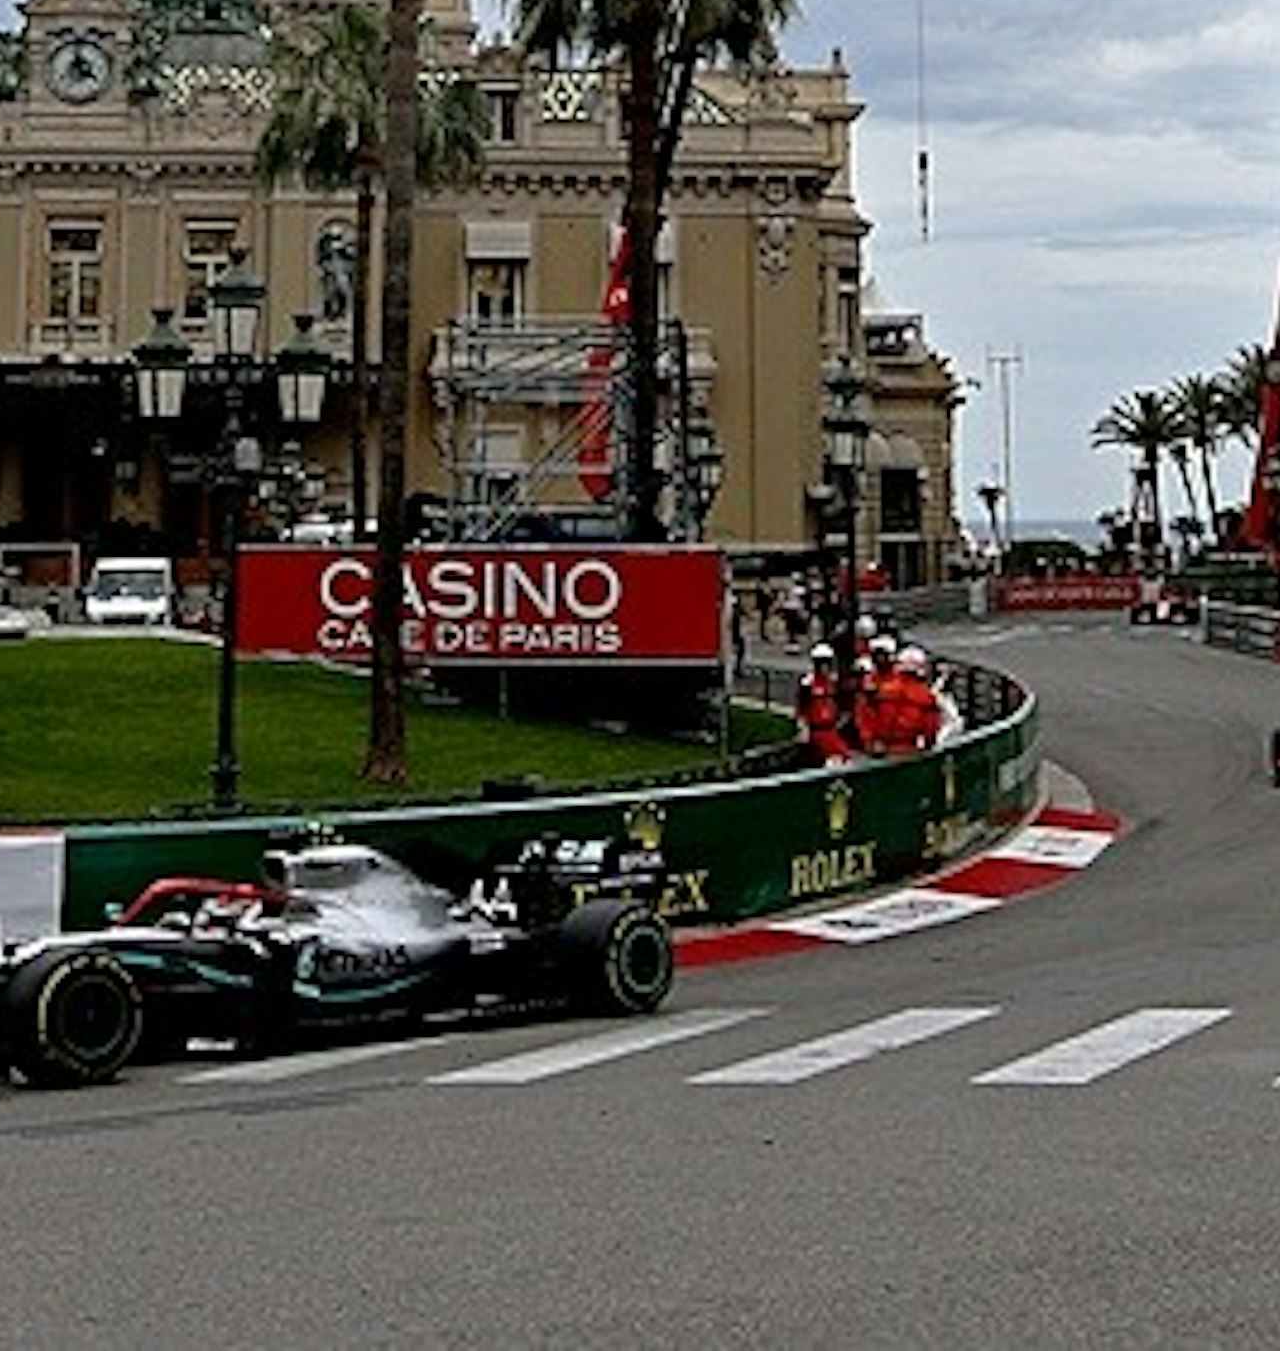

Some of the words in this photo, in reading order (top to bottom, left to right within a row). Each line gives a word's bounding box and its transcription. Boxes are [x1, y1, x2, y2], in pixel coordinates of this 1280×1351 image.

[317, 619, 424, 650] CAE
[436, 620, 489, 650] DE
[499, 620, 624, 652] PARIS
[789, 839, 878, 897] ROLEX
